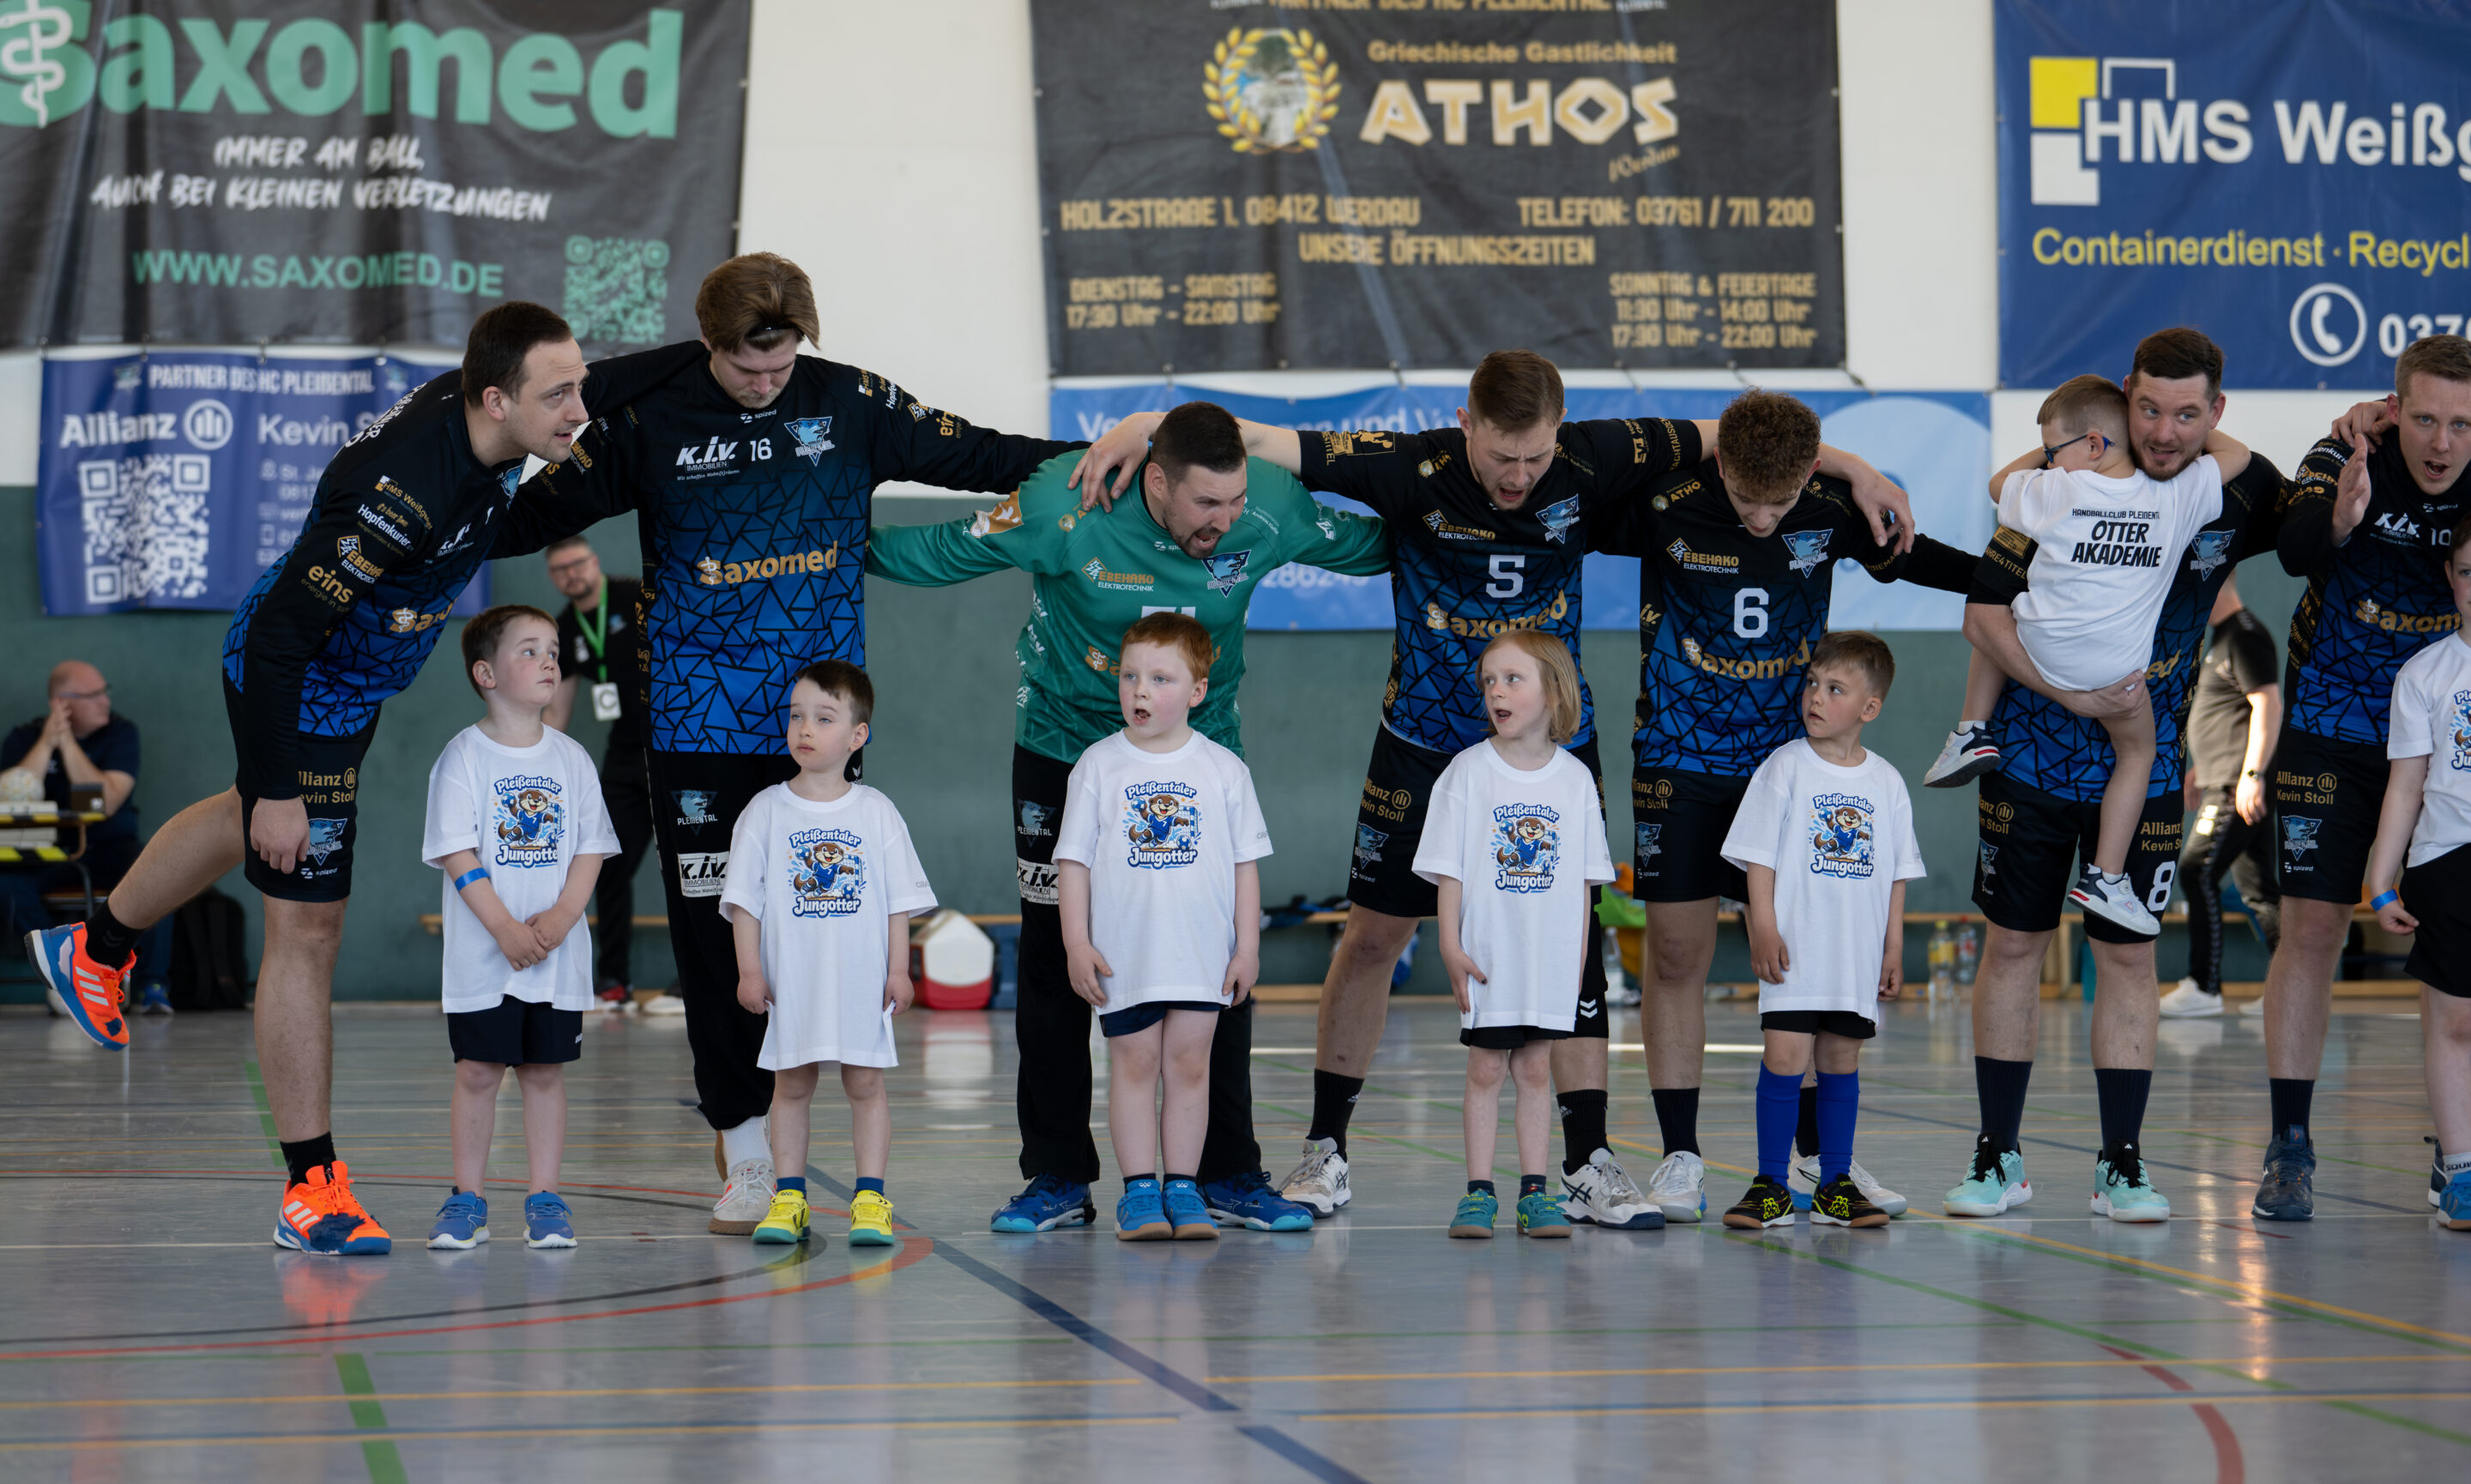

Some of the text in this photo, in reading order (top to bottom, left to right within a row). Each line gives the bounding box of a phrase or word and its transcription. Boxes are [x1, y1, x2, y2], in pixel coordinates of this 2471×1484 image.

[1368, 40, 1677, 63] Griechische Gastlichkeit
[1360, 75, 1678, 146] ATHOS
[2084, 99, 2252, 163] HMS
[214, 136, 425, 171] IMMER AM BALL,
[92, 171, 553, 221] AUCH BEI KLEINEN VERLETZUNGEN
[1245, 195, 1320, 225] 08412
[1326, 195, 1420, 226] WERDAU
[1517, 196, 1815, 228] TELEFON: 03761 / 711 200
[1299, 229, 1595, 266] UNSERE ÖFFNUNGSZEITEN
[2033, 226, 2325, 268] Containerdienst
[134, 250, 504, 297] WWW.SAXOMED.DE
[1610, 272, 1817, 297] SONNTAG & FEIERTAGE
[1070, 275, 1163, 302] DIENSTAG
[1185, 273, 1277, 299] SAMSTAG
[1066, 305, 1117, 329] 17:30
[1121, 304, 1162, 328] Uhr
[1184, 302, 1238, 325] 22:00
[1242, 302, 1281, 324] Uhr
[1664, 299, 1701, 322] Uhr
[1719, 299, 1769, 323] 14:00
[1773, 299, 1811, 323] Uhr
[1665, 324, 1703, 348] Uhr
[1721, 324, 1776, 348] 22:00
[1779, 324, 1818, 348] Uhr
[148, 365, 227, 389] PARTNER
[231, 367, 257, 390] DES
[259, 368, 281, 393] HC
[754, 409, 776, 419] spized
[59, 411, 177, 448] Allianz
[259, 414, 350, 445] Kevin
[750, 438, 772, 461] 16
[686, 461, 728, 472] IMMOBILIEN
[357, 504, 412, 547] Hopfenkurier
[2073, 508, 2126, 519] HANDBALLCLUB
[2091, 520, 2149, 544] OTTER
[2431, 528, 2451, 546] 10
[697, 540, 837, 585] Saxomed
[1683, 552, 1739, 567] EBEHAKO
[2070, 541, 2162, 568] AKADEMIE
[1098, 570, 1155, 584] EBEHAKO
[1486, 554, 1525, 599] 5
[1683, 562, 1739, 574] ELEKTROTECHNIK
[308, 564, 353, 604] eins
[1097, 581, 1154, 592] ELEKTROTECHNIK
[1734, 588, 1769, 638] 6
[2355, 599, 2464, 633] Saxom
[298, 770, 341, 787] llianz
[494, 775, 562, 795] Pleißentaler
[1125, 781, 1198, 799] Pleißentaler
[1364, 776, 1390, 801] llianz
[2276, 770, 2313, 787] Allianz
[299, 789, 355, 804] evin Stoll
[1646, 798, 1668, 810] Stoll
[1812, 793, 1875, 814] Pleißentaler
[2276, 789, 2334, 805] Kevin Stoll
[1377, 805, 1405, 822] Stoll
[1493, 802, 1560, 823] Pleißentaler
[1986, 817, 2009, 835] Stoll
[2141, 822, 2180, 836] Allianz
[789, 829, 861, 848] Pleißentaler
[2142, 840, 2173, 852] Kevin
[1127, 846, 1198, 870] Jungotter
[1810, 854, 1874, 878] Jungotter
[1495, 870, 1554, 894] Jungotter
[2147, 860, 2177, 913] 8
[792, 896, 861, 918] Jungotter
